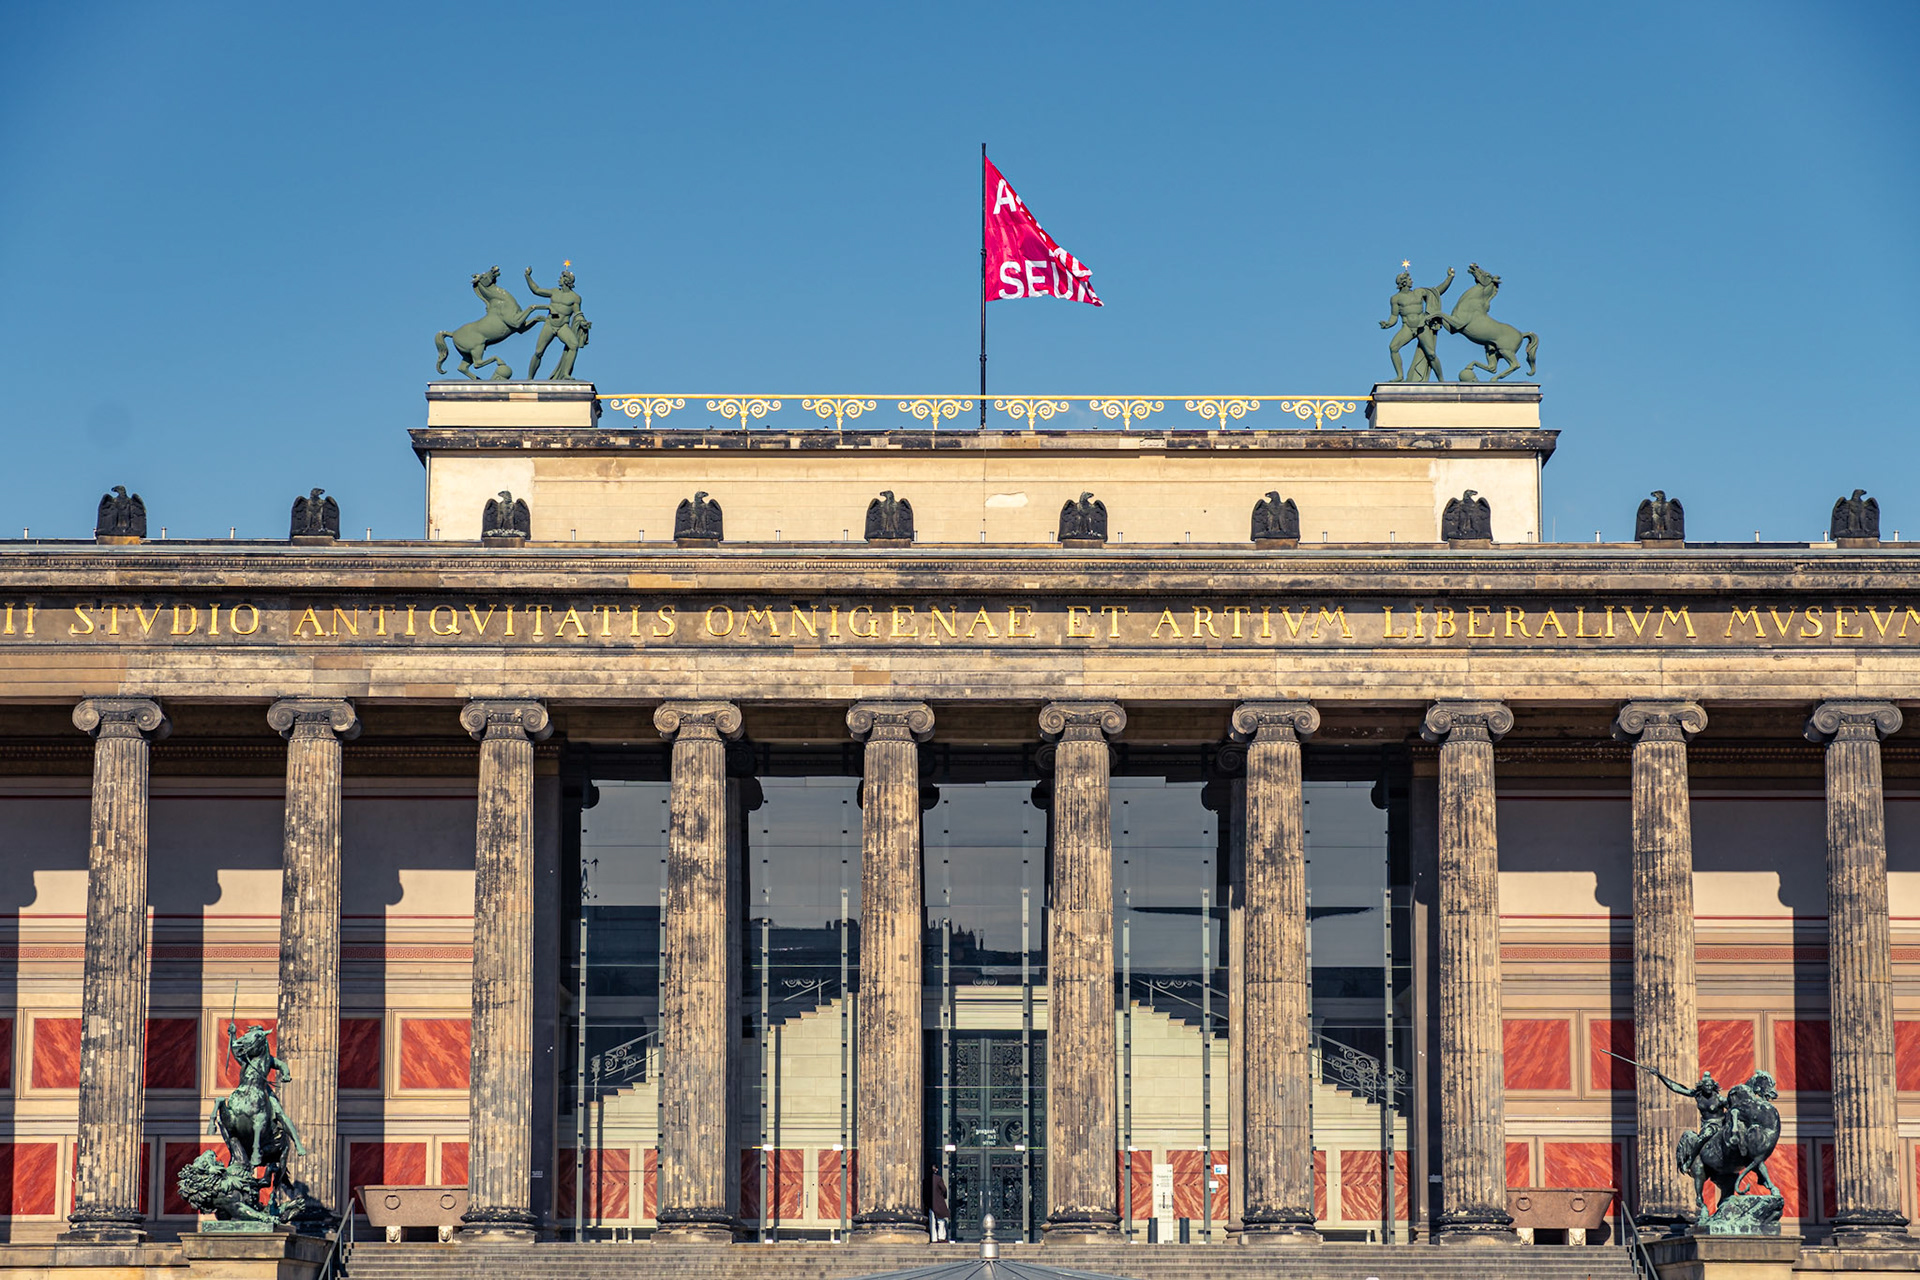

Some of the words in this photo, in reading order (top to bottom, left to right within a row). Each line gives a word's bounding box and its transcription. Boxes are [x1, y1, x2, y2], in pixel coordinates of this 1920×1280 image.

[70, 603, 260, 636] STVDIO
[293, 603, 676, 638] ANTIQVITATIS
[704, 604, 1036, 639] OMNIGENAE
[1066, 605, 1129, 639] ET
[1150, 605, 1353, 639] ARTIVM
[1382, 605, 1698, 639] LIBERALIVM
